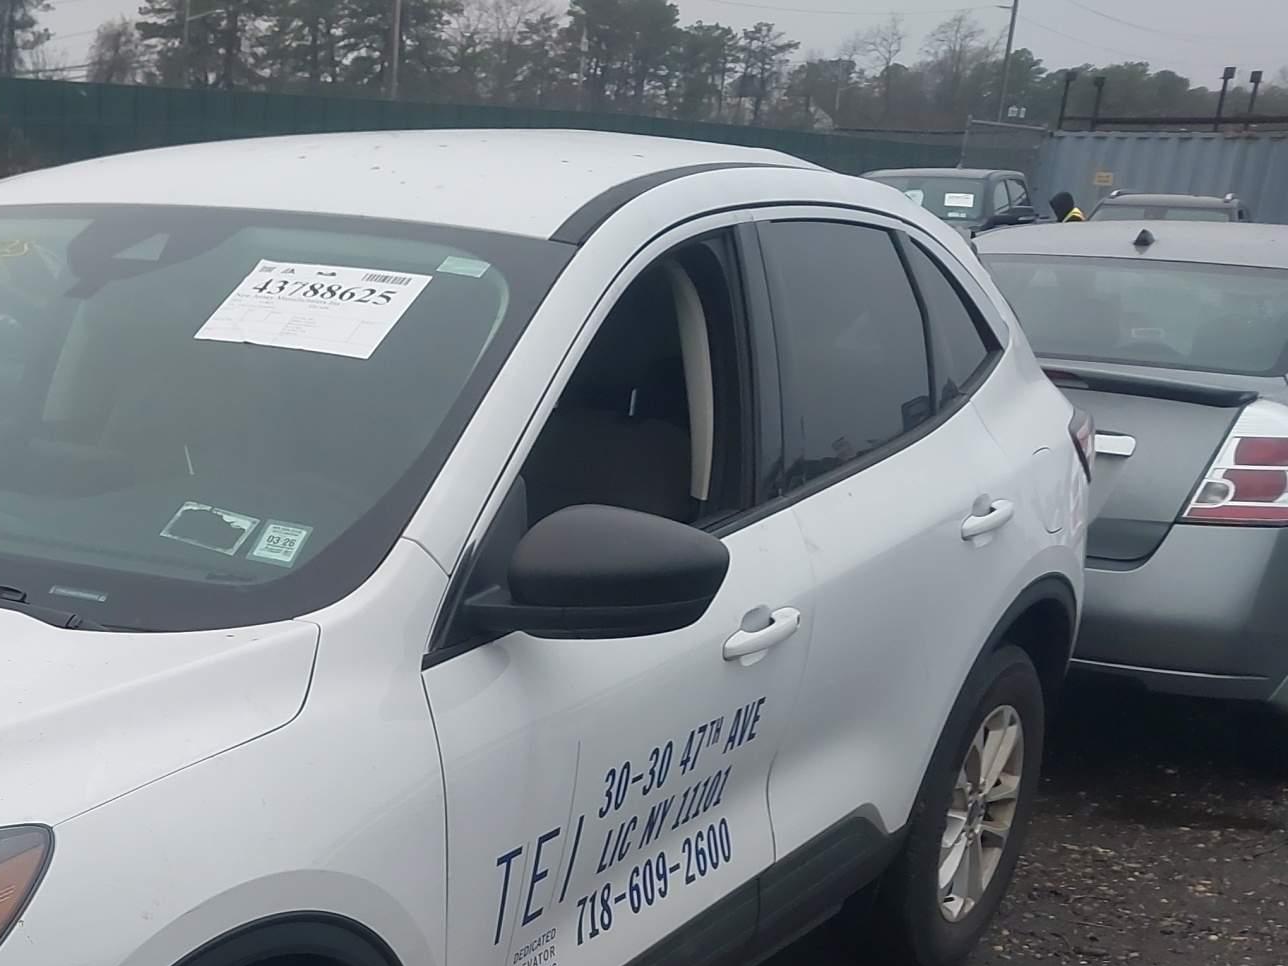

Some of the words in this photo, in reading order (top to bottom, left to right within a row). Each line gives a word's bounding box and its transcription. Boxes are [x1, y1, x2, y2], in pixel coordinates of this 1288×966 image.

[253, 278, 398, 306] 43788625
[599, 740, 673, 819] 30-30
[679, 716, 724, 776] 47TH
[722, 696, 767, 754] AVE
[596, 815, 638, 875] LIC
[638, 795, 675, 850] NY
[671, 765, 732, 831] 11101
[576, 817, 732, 947] 718-609-2600
[513, 927, 557, 965] DEDICATED
